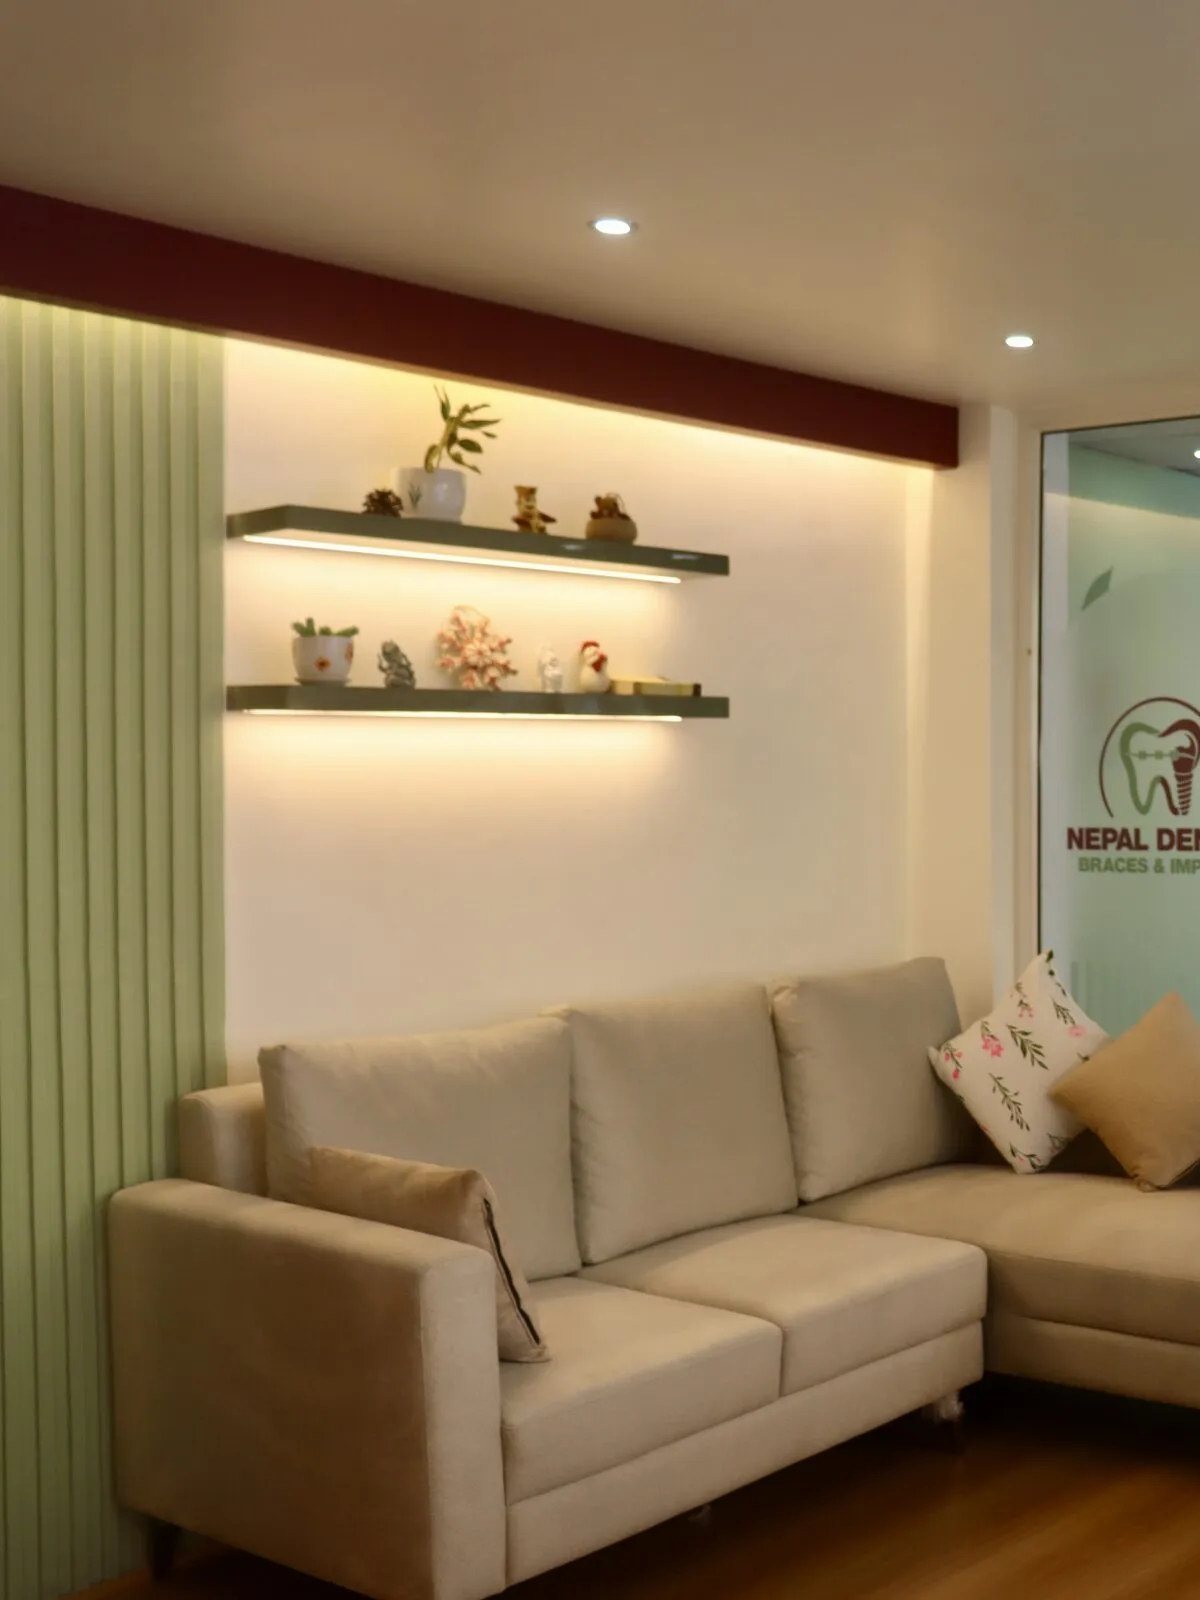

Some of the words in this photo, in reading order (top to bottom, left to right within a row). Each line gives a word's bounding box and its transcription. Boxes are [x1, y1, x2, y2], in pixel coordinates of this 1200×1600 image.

[1067, 828, 1149, 850] NEPAL
[1078, 857, 1149, 873] BRACES
[1153, 858, 1165, 874] &
